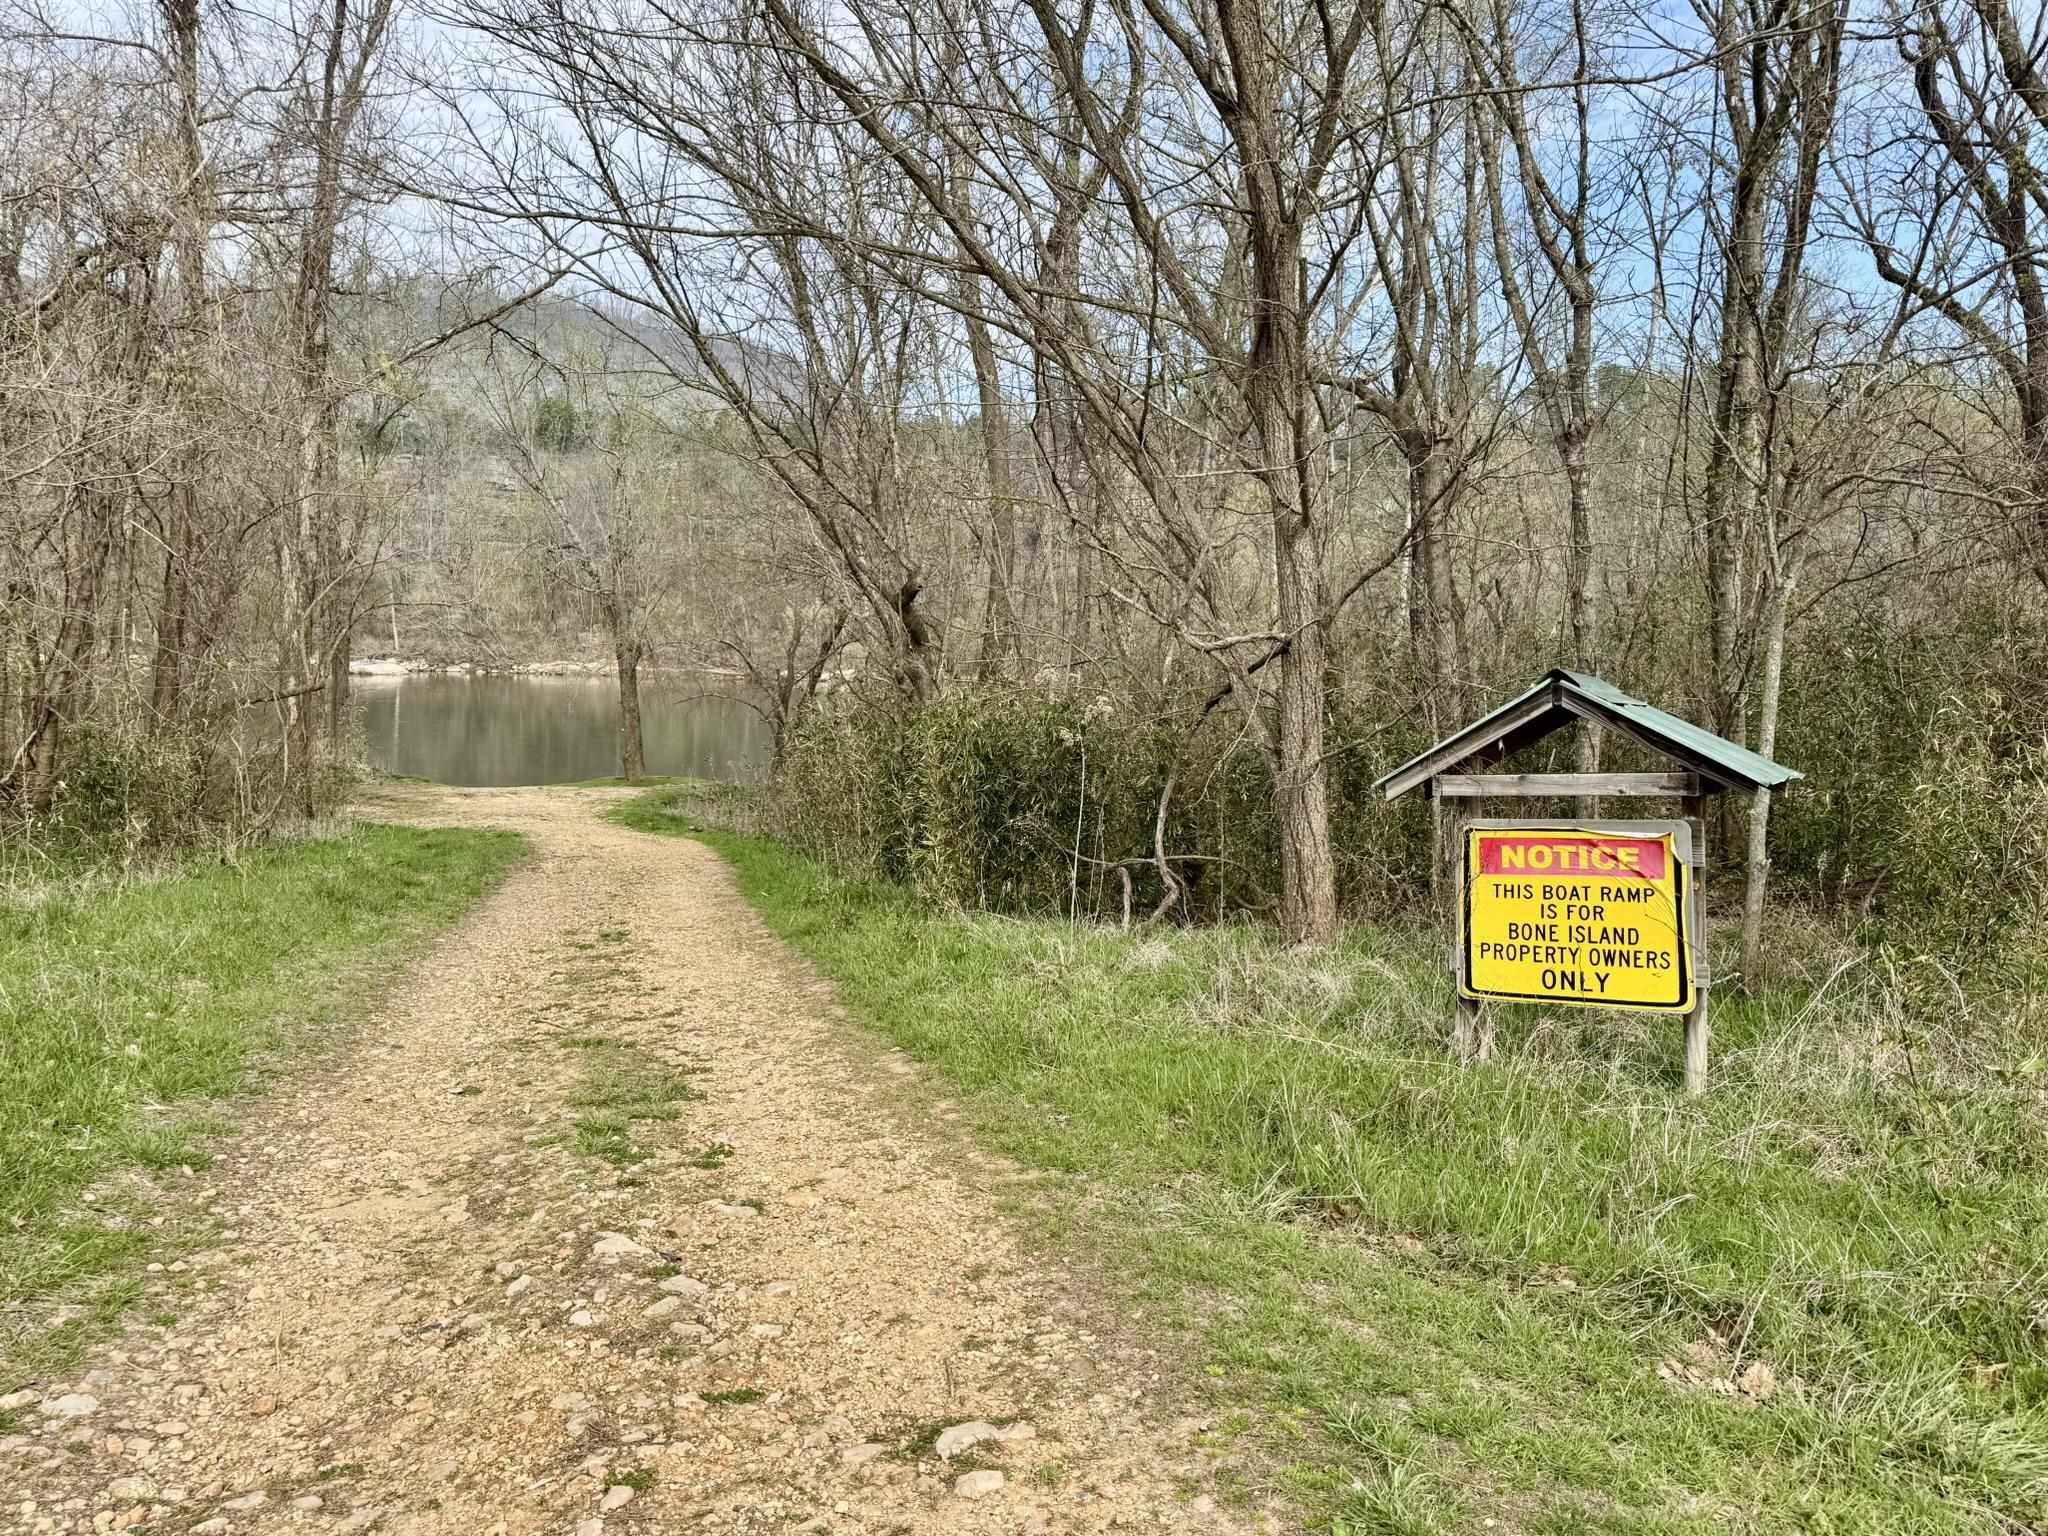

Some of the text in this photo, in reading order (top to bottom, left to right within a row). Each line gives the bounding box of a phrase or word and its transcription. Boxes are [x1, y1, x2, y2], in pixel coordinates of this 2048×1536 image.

[1500, 845, 1640, 870] NOTICE
[1493, 883, 1655, 903] THIS BOAT RAMP
[1540, 904, 1604, 921] IS FOR
[1508, 923, 1640, 945] BONE ISLAND
[1480, 943, 1671, 970] PROPERTY OWNERS
[1542, 970, 1610, 993] ONLY
